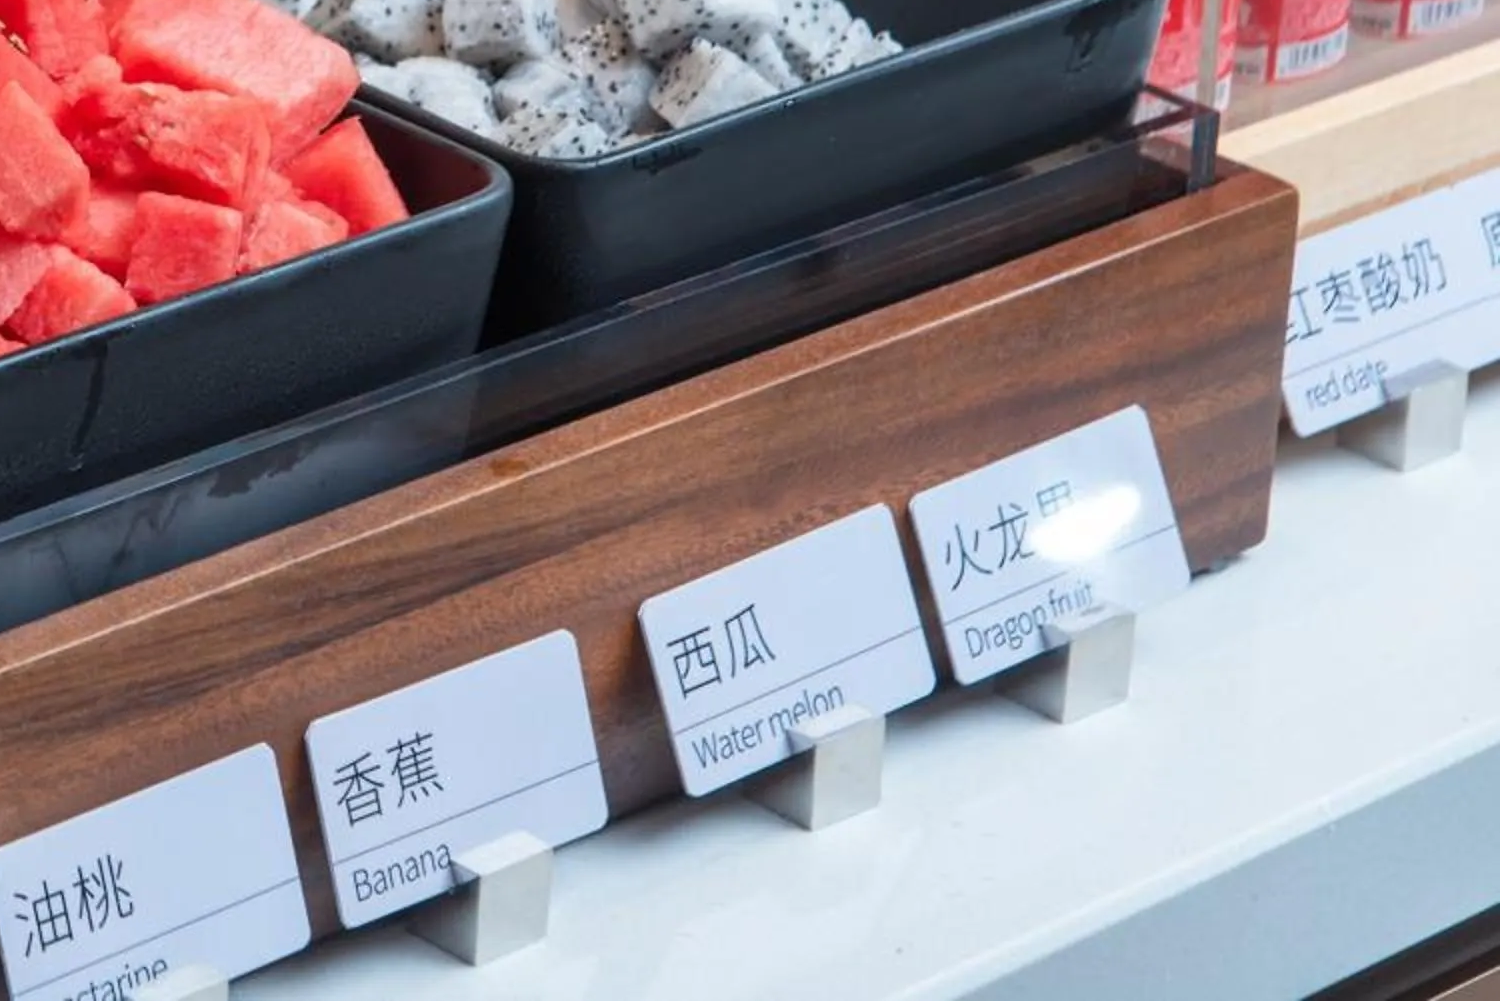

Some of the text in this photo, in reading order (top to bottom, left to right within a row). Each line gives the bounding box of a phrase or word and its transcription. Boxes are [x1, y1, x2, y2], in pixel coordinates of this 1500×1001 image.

[1305, 368, 1340, 412] red
[667, 603, 777, 700] 西瓜
[964, 604, 1047, 659] Dragon
[333, 731, 445, 828] 香蕉
[13, 854, 135, 958] 油桃
[353, 843, 453, 903] Banana
